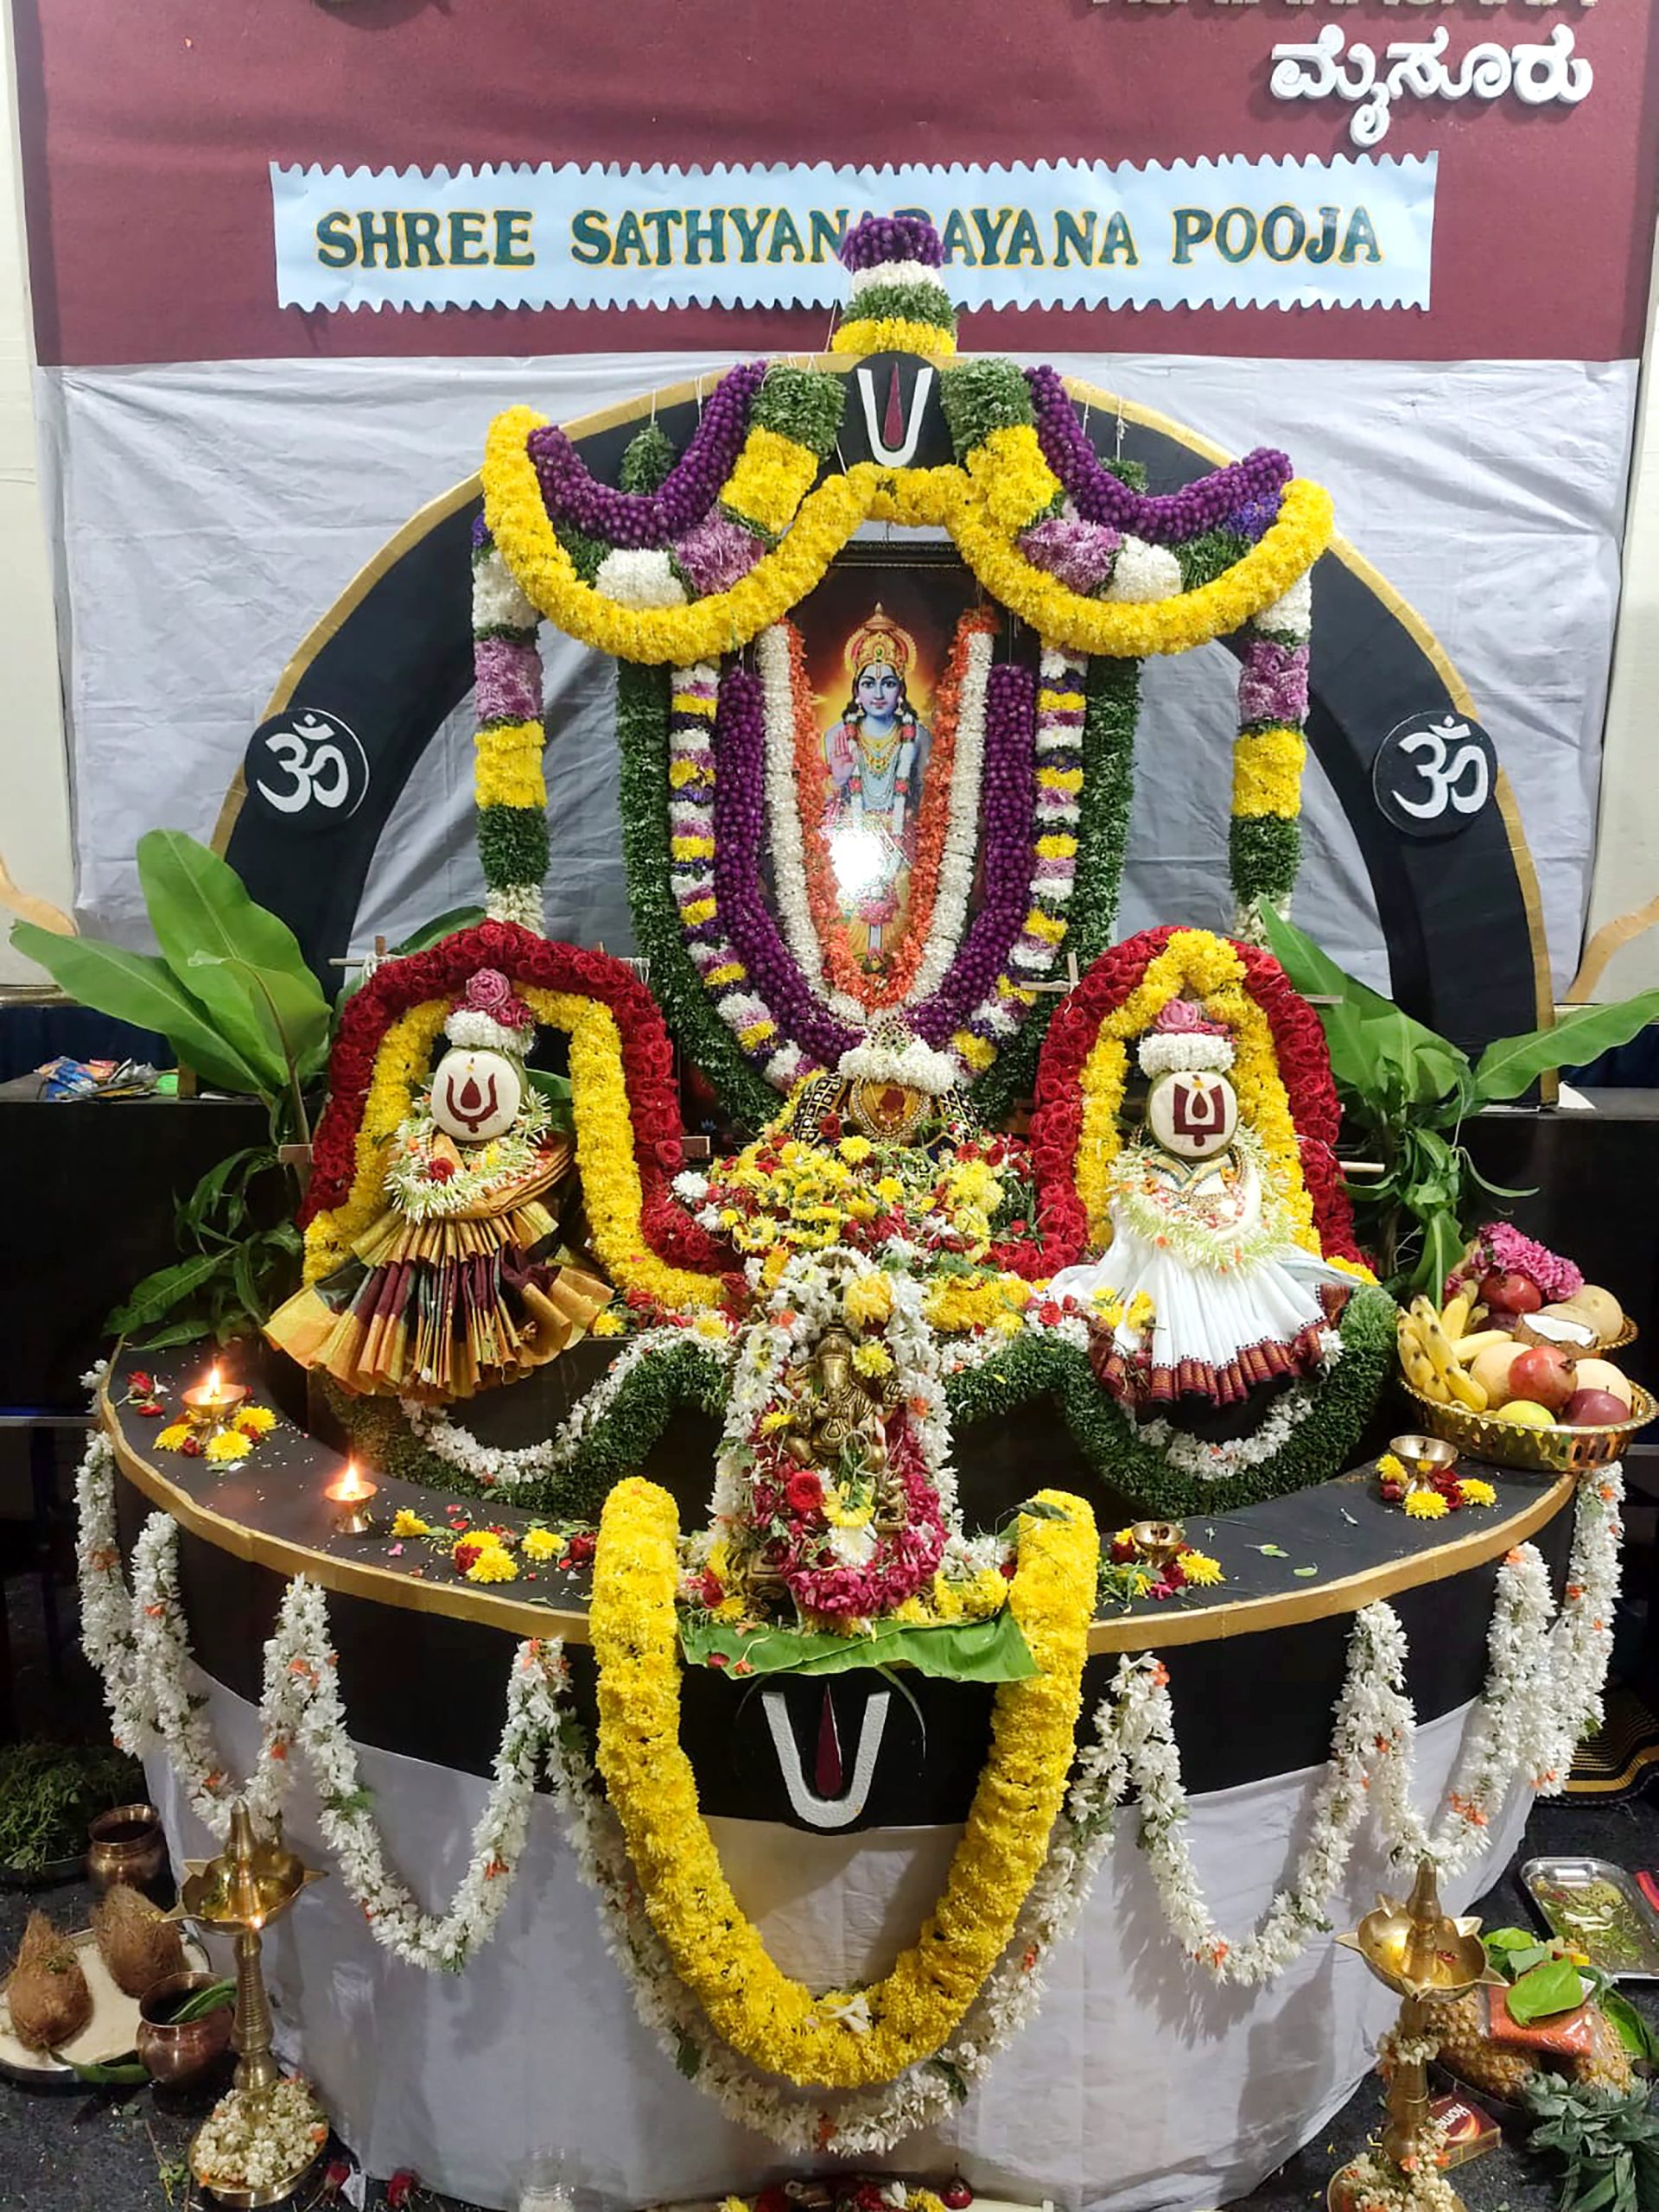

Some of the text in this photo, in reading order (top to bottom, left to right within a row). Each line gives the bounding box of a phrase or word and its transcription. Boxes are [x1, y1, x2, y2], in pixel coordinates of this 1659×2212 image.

[1269, 23, 1594, 148] ಮೈಸೂರು
[315, 203, 1382, 269] SHREE SATHYANAYANA POOJA
